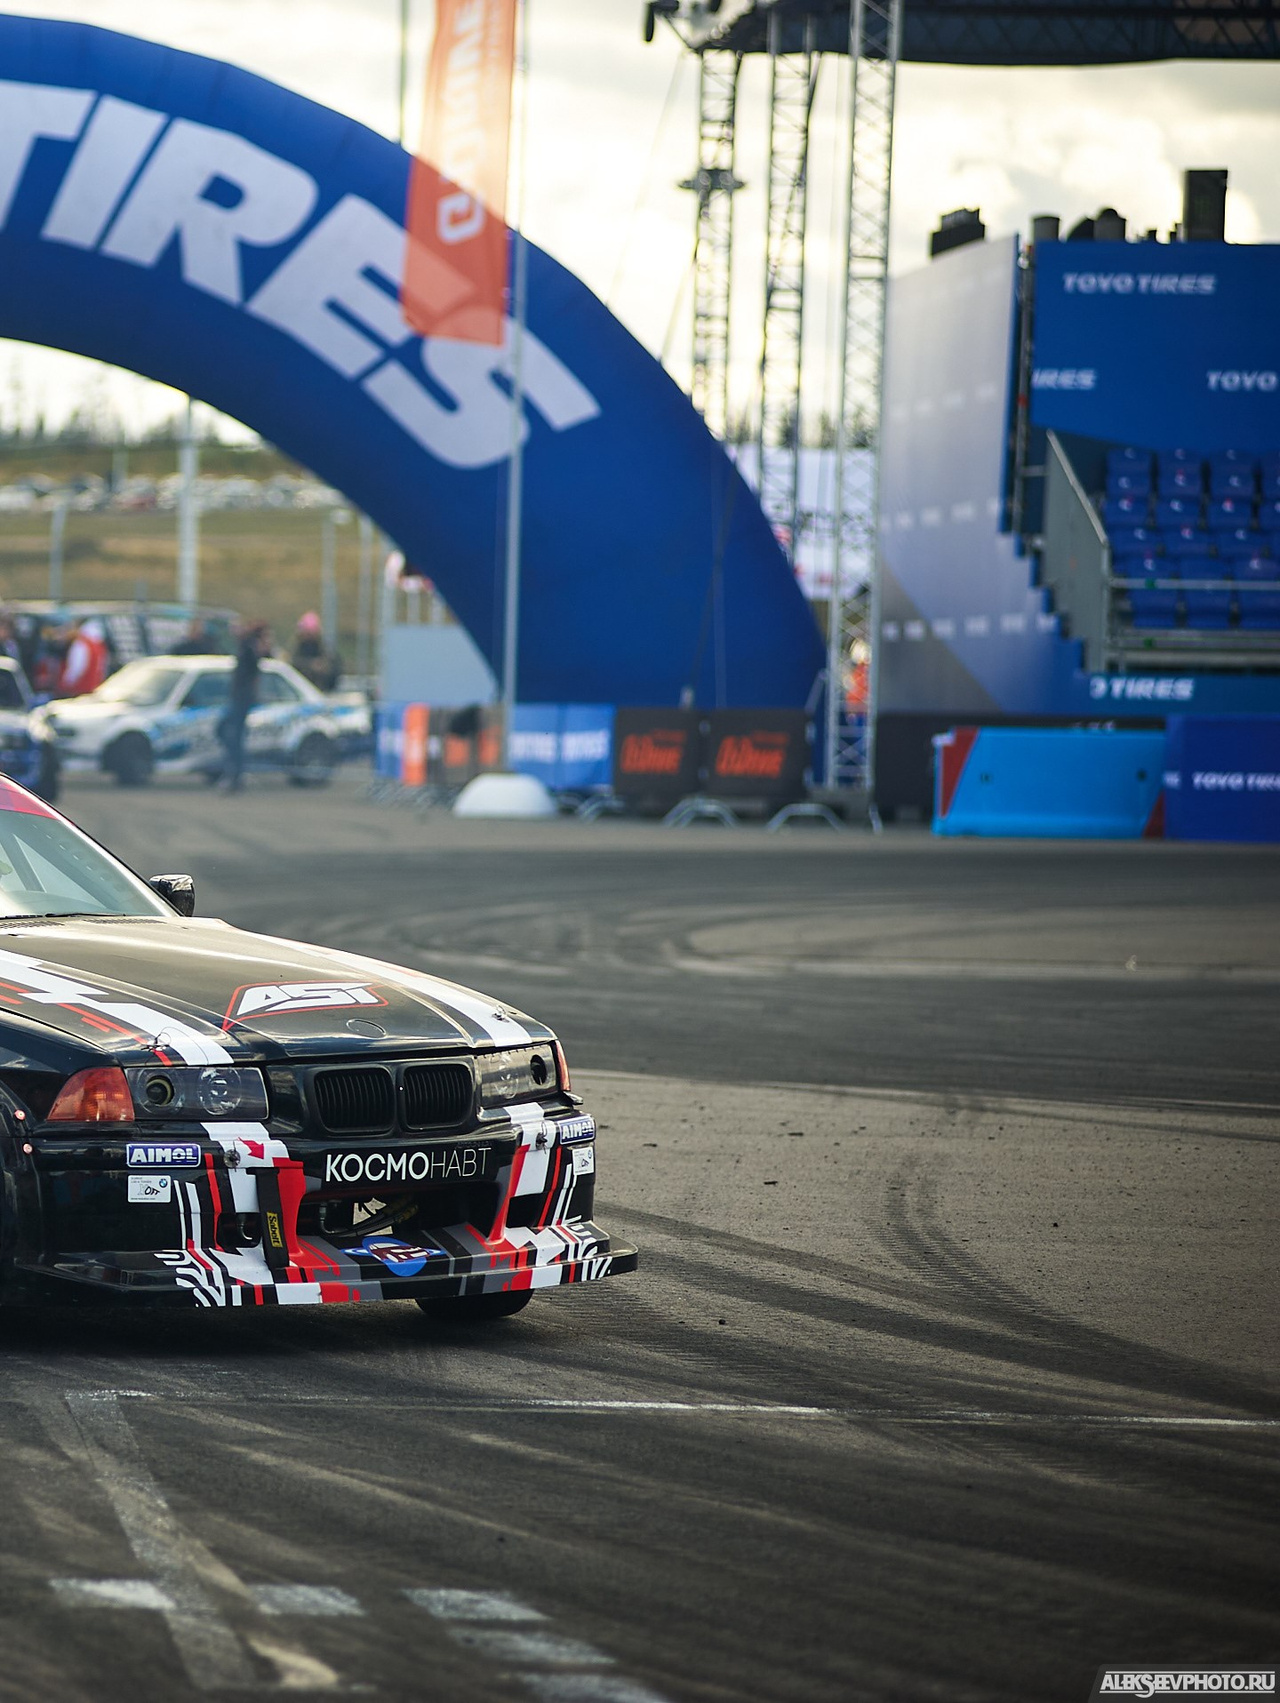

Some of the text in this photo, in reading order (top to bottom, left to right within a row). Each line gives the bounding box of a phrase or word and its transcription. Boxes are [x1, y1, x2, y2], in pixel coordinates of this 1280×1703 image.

[1063, 272, 1216, 295] TOYO TIRES
[1207, 370, 1278, 391] TOYO
[1110, 676, 1195, 699] TIRES
[130, 1147, 197, 1163] AIMOL
[325, 1147, 492, 1182] КОСМОНАВТ
